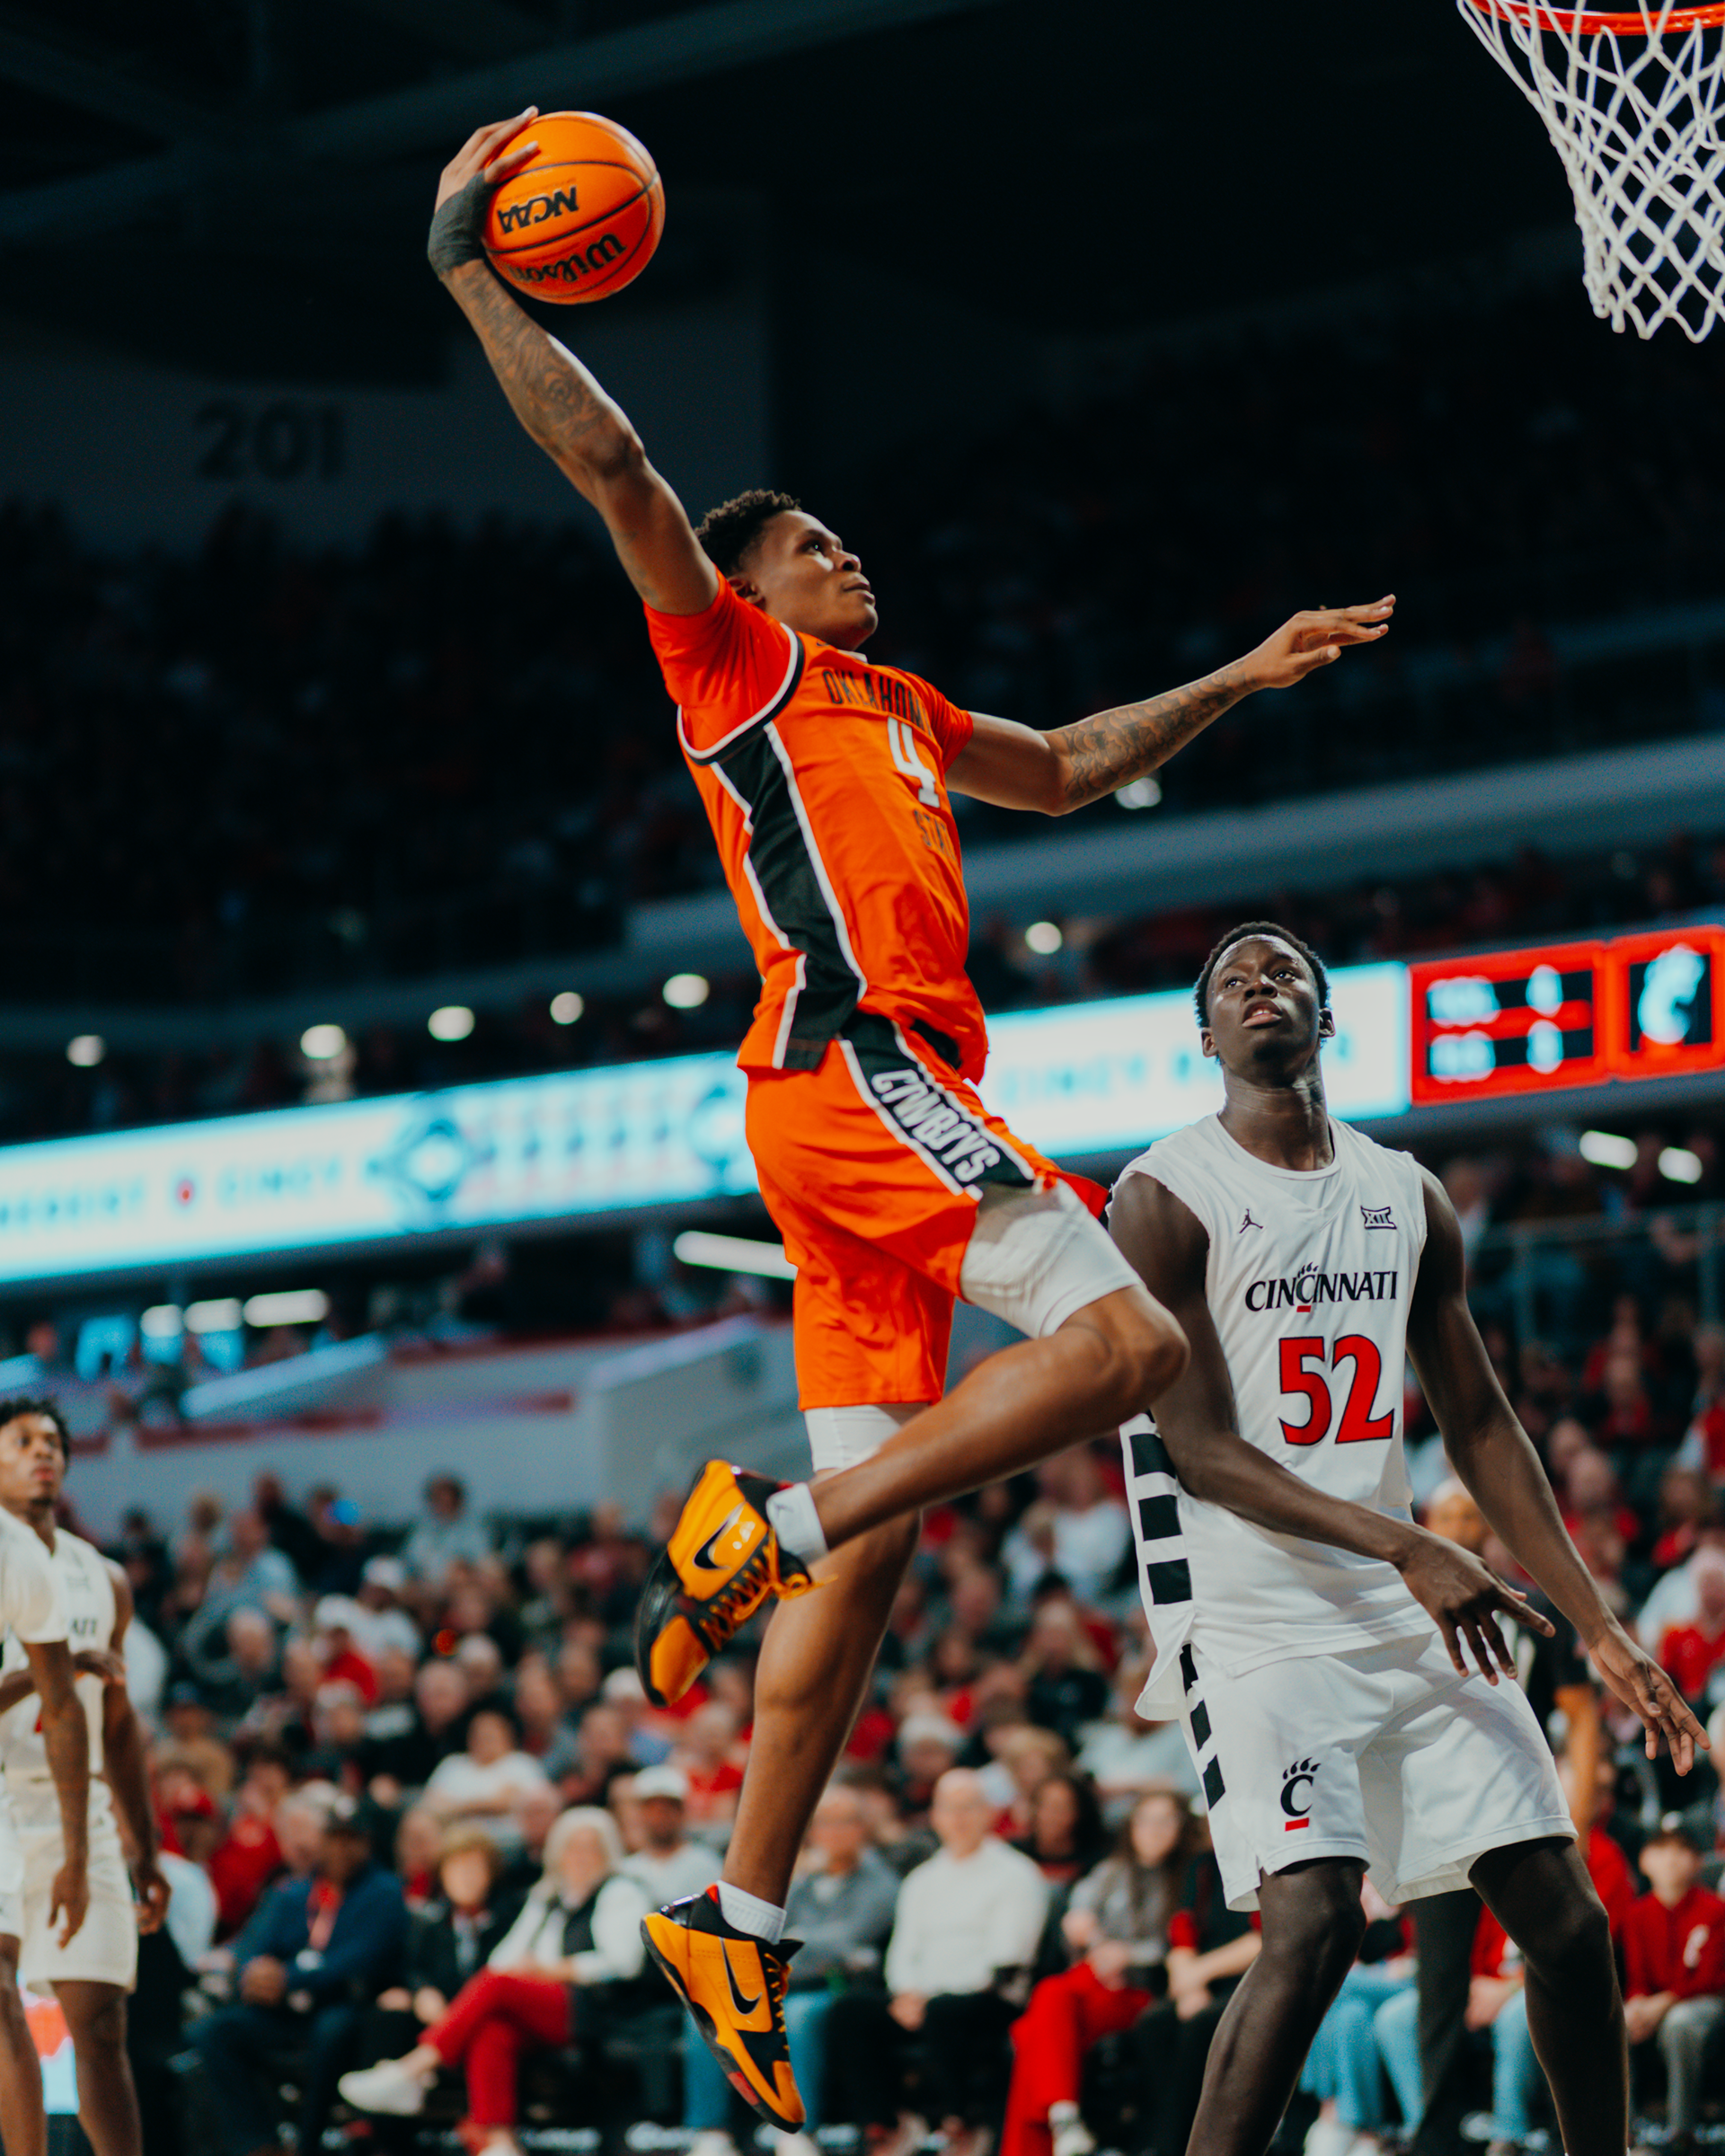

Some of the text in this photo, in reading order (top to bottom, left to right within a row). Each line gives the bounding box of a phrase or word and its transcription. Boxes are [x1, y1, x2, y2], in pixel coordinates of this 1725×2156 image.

[497, 185, 579, 234] NCAA
[506, 234, 627, 283] Wilson
[193, 399, 347, 480] 201
[822, 669, 933, 738] OKLAHOM
[887, 715, 941, 808] 4
[871, 1069, 1001, 1182] COWBOYS
[1244, 1269, 1398, 1312] CINCINNATI
[1278, 1333, 1395, 1446] 52
